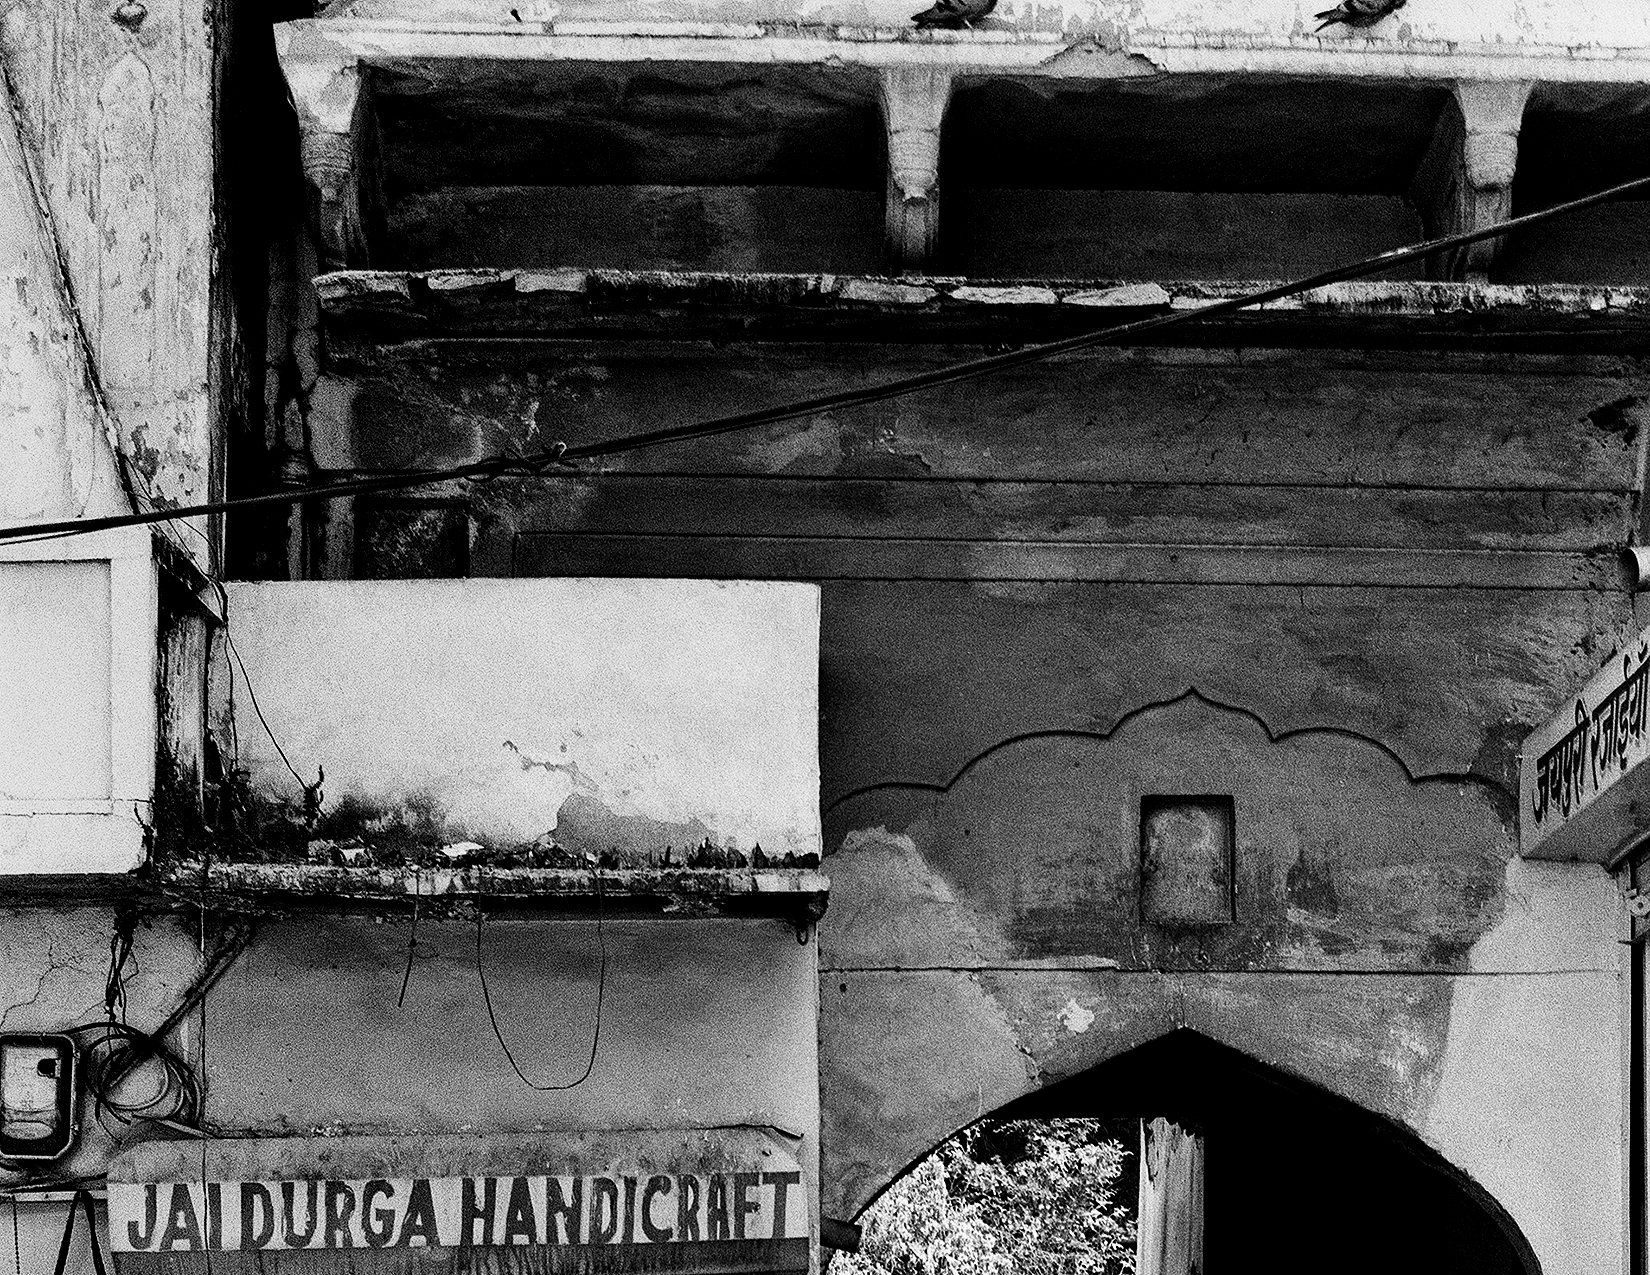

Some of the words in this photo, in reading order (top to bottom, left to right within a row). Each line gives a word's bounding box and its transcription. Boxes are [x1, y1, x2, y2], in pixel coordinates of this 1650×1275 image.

[1532, 698, 1591, 825] जयपुरी
[127, 1182, 222, 1251] JAI
[240, 1178, 441, 1250] DURGA
[459, 1170, 801, 1246] HANDICRAFT
